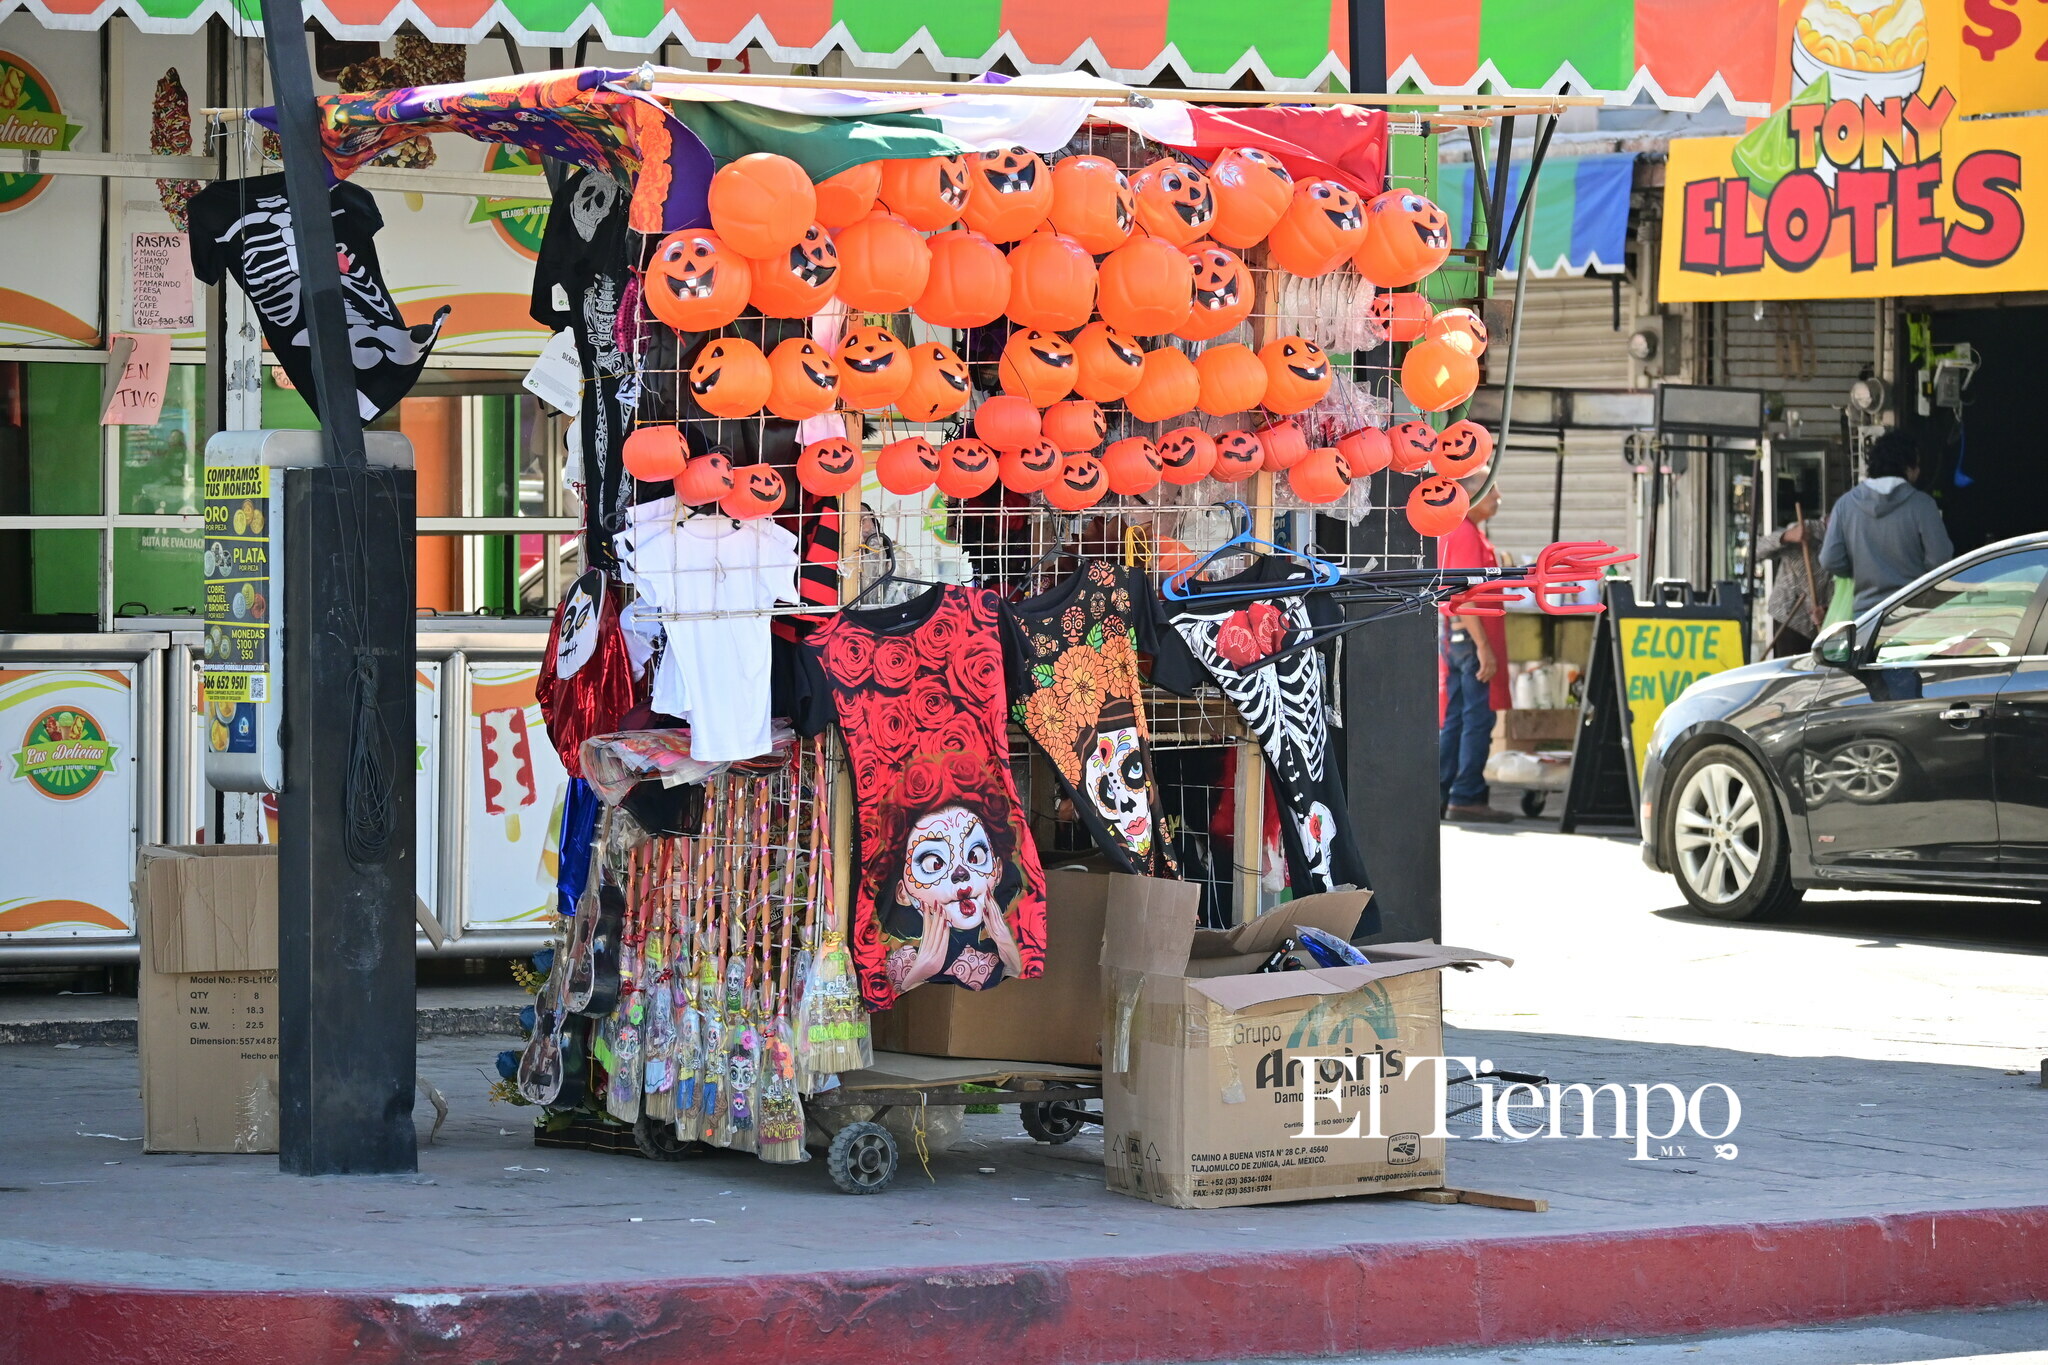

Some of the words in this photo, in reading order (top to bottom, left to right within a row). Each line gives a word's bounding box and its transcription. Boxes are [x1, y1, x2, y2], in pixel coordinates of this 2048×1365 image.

[1788, 85, 1957, 169] TONY
[1680, 149, 2025, 276] ELOTES
[136, 235, 181, 248] RASPAS
[139, 257, 170, 265] CHAMOY
[125, 362, 149, 380] EN
[113, 389, 159, 409] TIVO
[207, 467, 260, 482] COMPRAMOS
[206, 483, 220, 497] TUS
[222, 481, 262, 496] MONEDAS
[204, 506, 229, 523] ORO
[161, 537, 170, 547] DE
[233, 547, 267, 564] PLATA
[231, 629, 265, 639] MONEDAS
[236, 639, 253, 650] $100
[253, 640, 259, 649] Y
[1631, 625, 1721, 660] ELOTE
[241, 650, 254, 661] $50
[216, 675, 230, 689] 652
[231, 676, 248, 690] 9501
[1628, 675, 1657, 701] EN
[1659, 671, 1712, 706] VA
[26, 748, 48, 764] Las
[52, 742, 104, 760] Delicias
[190, 976, 216, 984] Model
[218, 976, 236, 984] No.:
[254, 992, 260, 1000] 8
[240, 1038, 279, 1046] 557x487
[1234, 1023, 1282, 1047] Grupo
[1191, 1153, 1221, 1162] CAMINO
[1230, 1151, 1253, 1160] BUENA
[1255, 1149, 1275, 1159] VISTA
[1285, 1148, 1293, 1156] 28
[1295, 1147, 1308, 1155] C.P.
[1191, 1162, 1240, 1173] TLAJOMULCO
[1241, 1162, 1251, 1170] DE
[1282, 1158, 1296, 1167] JAL.
[1194, 1179, 1209, 1187] TEL:
[1210, 1178, 1224, 1186] +52
[1225, 1177, 1238, 1187] (33)
[1193, 1189, 1209, 1197] FAX:
[1210, 1188, 1224, 1196] +52
[1225, 1188, 1238, 1197] (33)
